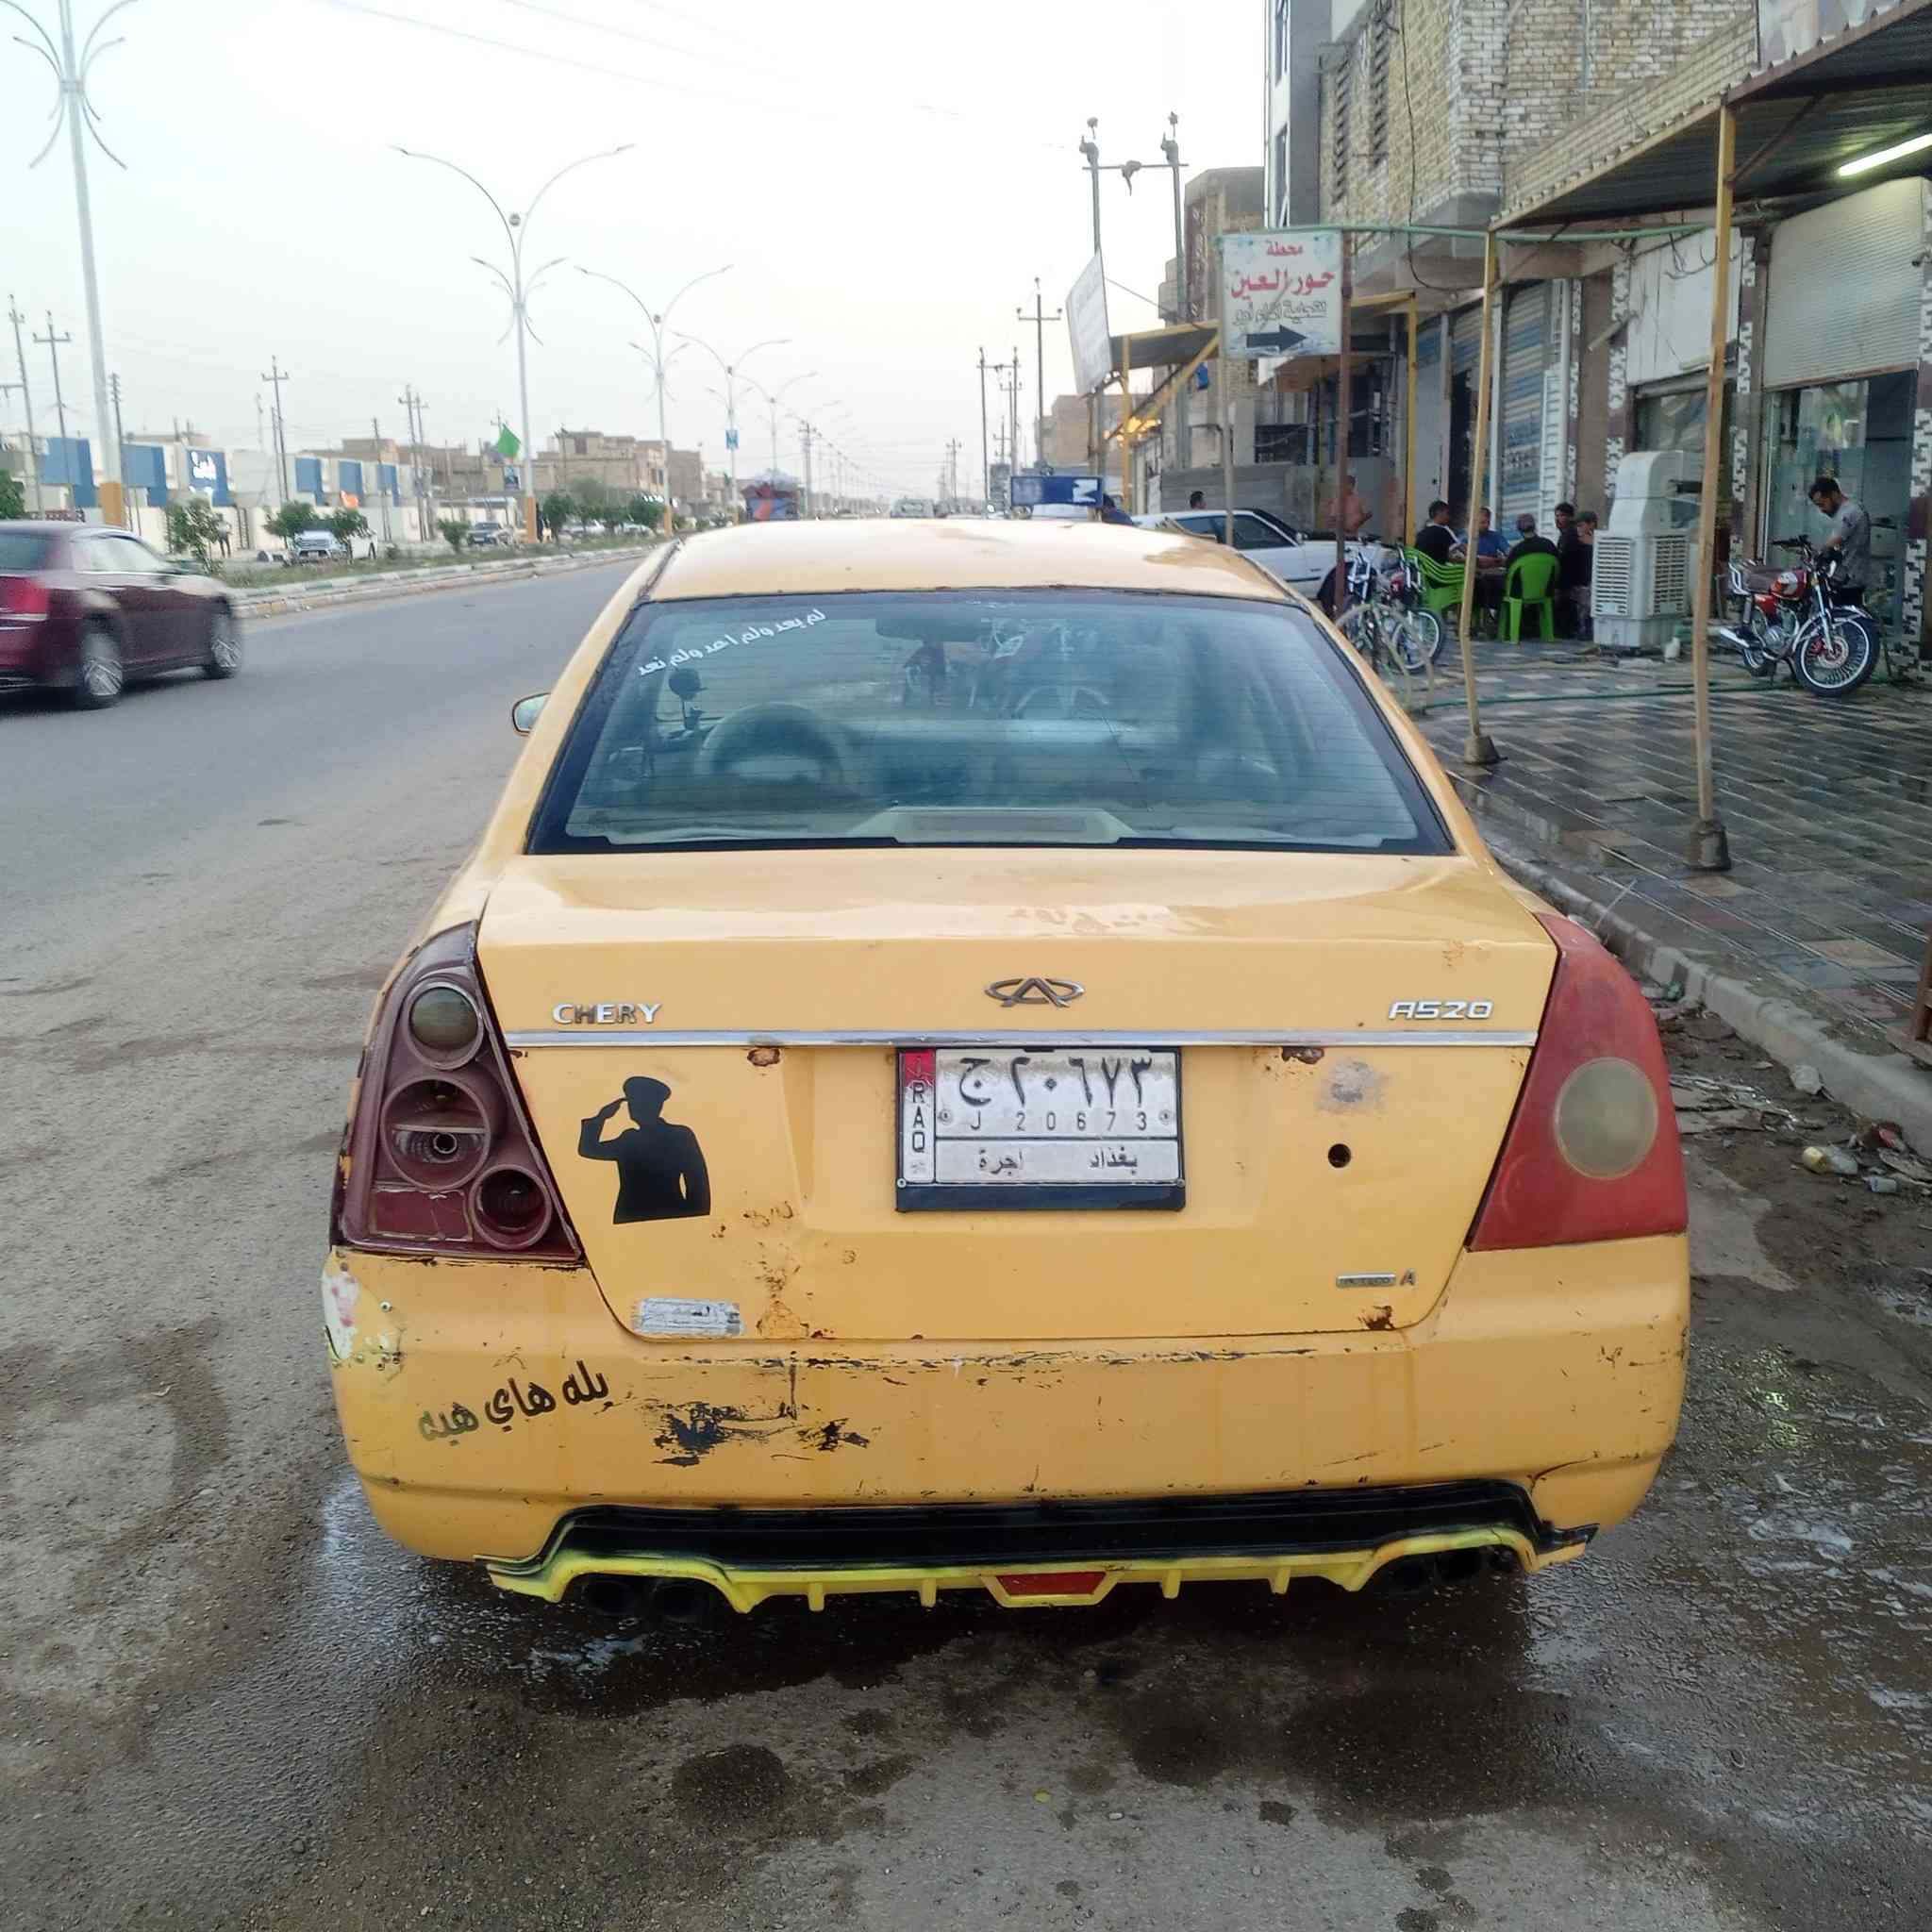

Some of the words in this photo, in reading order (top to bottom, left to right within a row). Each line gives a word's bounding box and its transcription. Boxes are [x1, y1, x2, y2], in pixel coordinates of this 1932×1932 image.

[1266, 240, 1304, 257] محطة
[1230, 265, 1289, 301] العين
[1291, 272, 1335, 296] حور
[774, 618, 808, 633] يعد
[807, 608, 826, 626] لم
[741, 625, 774, 644] ولم
[638, 656, 667, 675] نعد
[669, 648, 704, 667] ولم
[552, 1002, 662, 1024] CHERY
[1388, 1000, 1493, 1020] A520
[978, 1148, 1024, 1176] اجرة
[1089, 1145, 1139, 1175] بغداد
[485, 1377, 557, 1433] هاي
